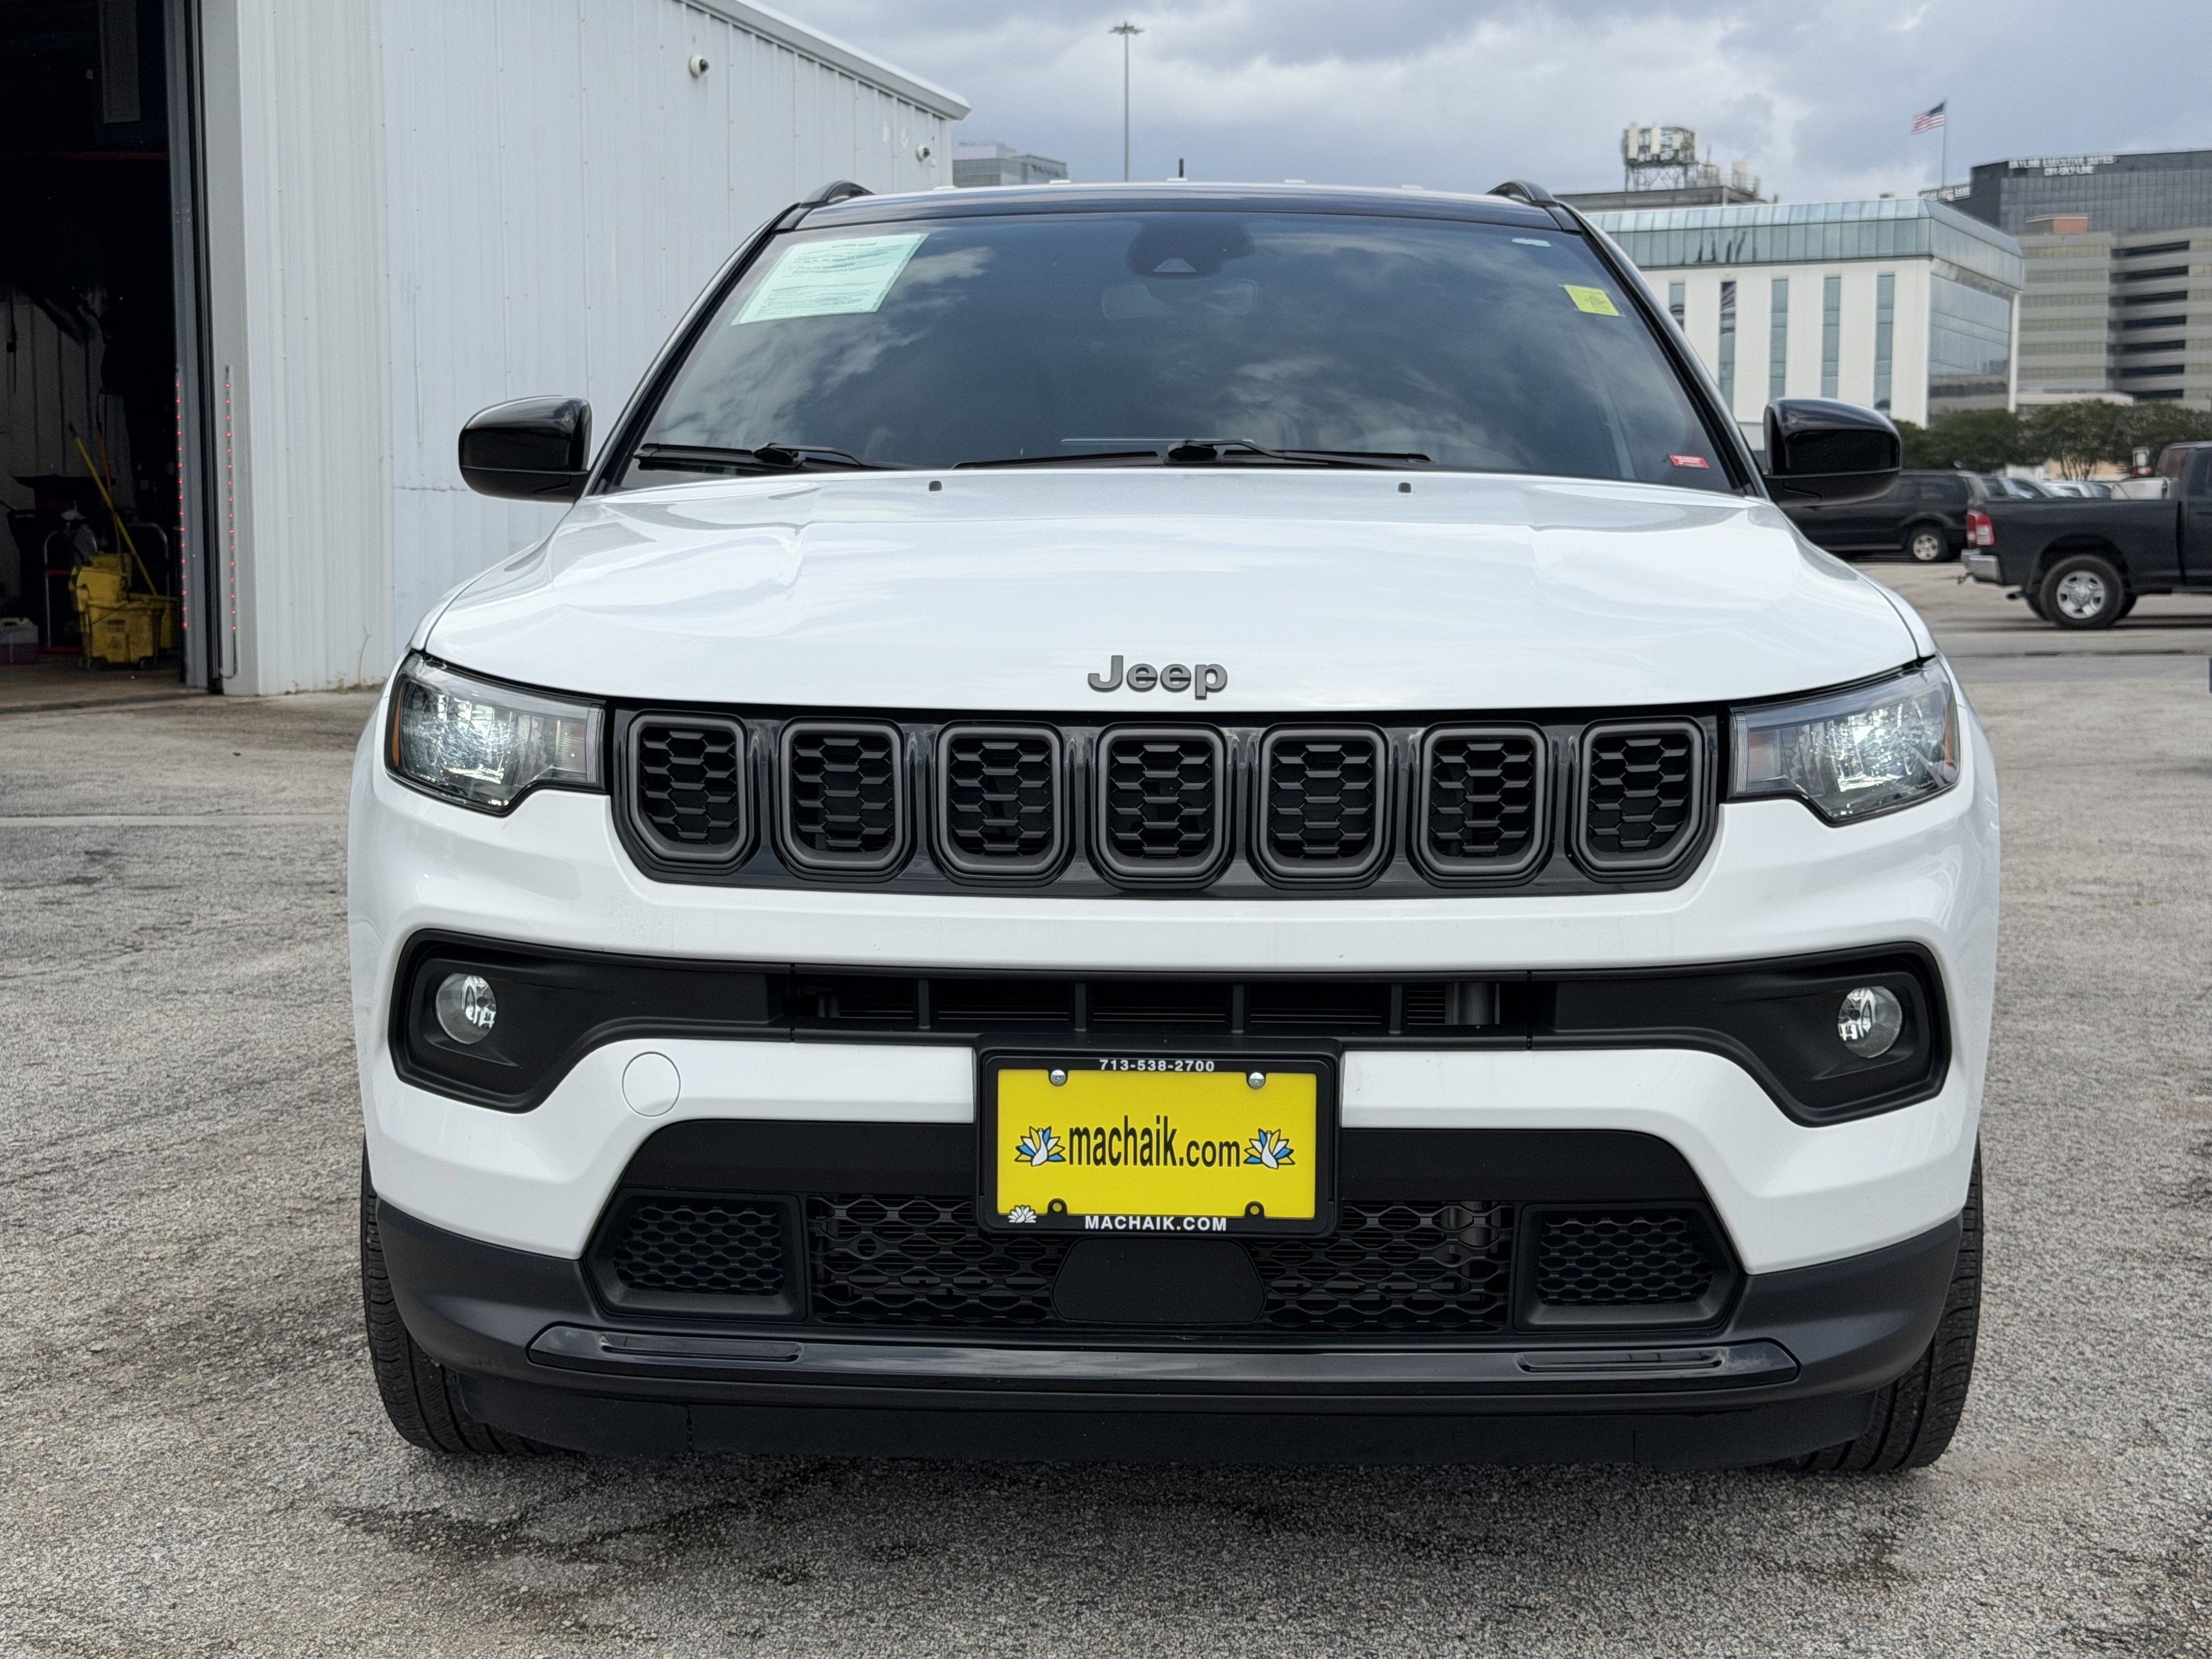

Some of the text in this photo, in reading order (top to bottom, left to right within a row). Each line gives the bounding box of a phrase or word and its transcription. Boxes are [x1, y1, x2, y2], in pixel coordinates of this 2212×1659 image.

[1088, 655, 1228, 700] Jeep
[1099, 1059, 1215, 1072] 713-538-2700
[1069, 1115, 1240, 1167] machaik.com
[1085, 1215, 1227, 1232] MACHAIK.COM
